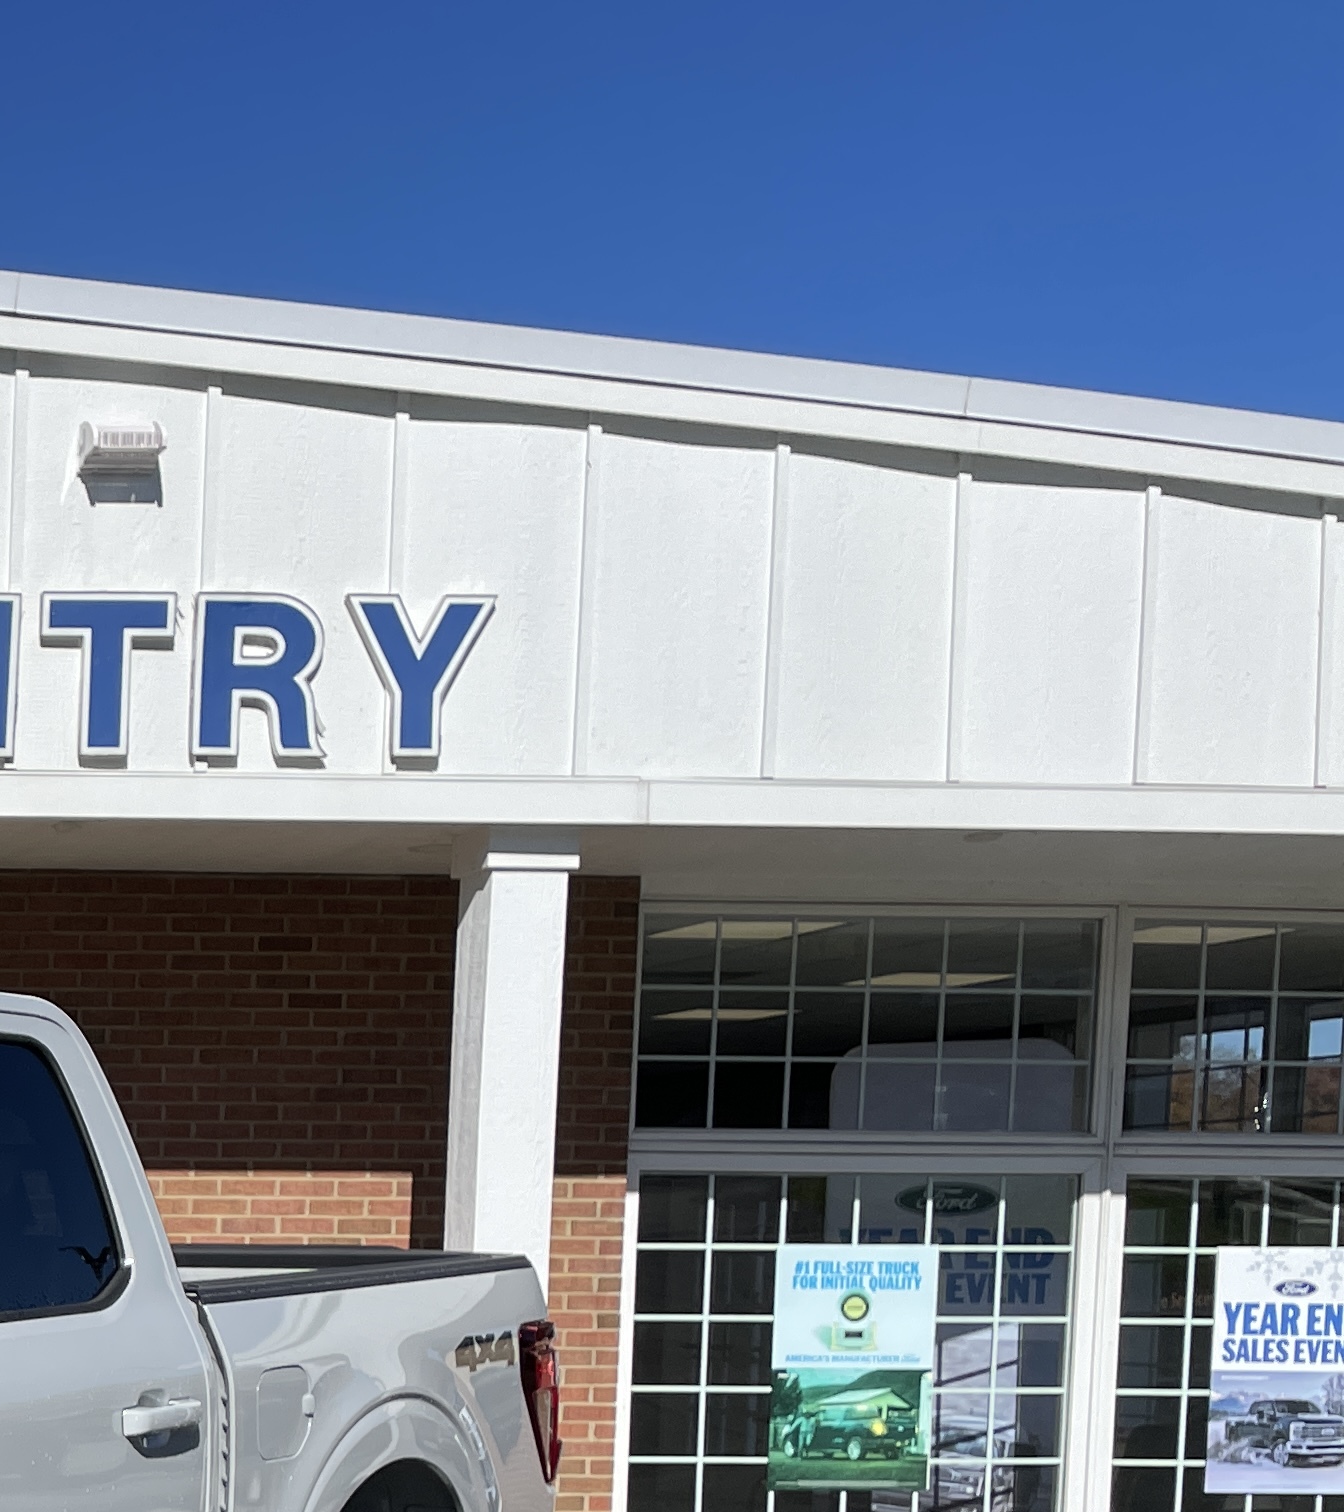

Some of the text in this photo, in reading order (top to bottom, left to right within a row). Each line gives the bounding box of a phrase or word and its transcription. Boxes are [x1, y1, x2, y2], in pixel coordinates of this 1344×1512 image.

[794, 1260, 920, 1275] #1 FULL-SIZE TRUCK
[792, 1275, 923, 1293] FOR INITIAL QUALITY
[1223, 1301, 1302, 1337] YEAR
[1221, 1337, 1290, 1364] SALES
